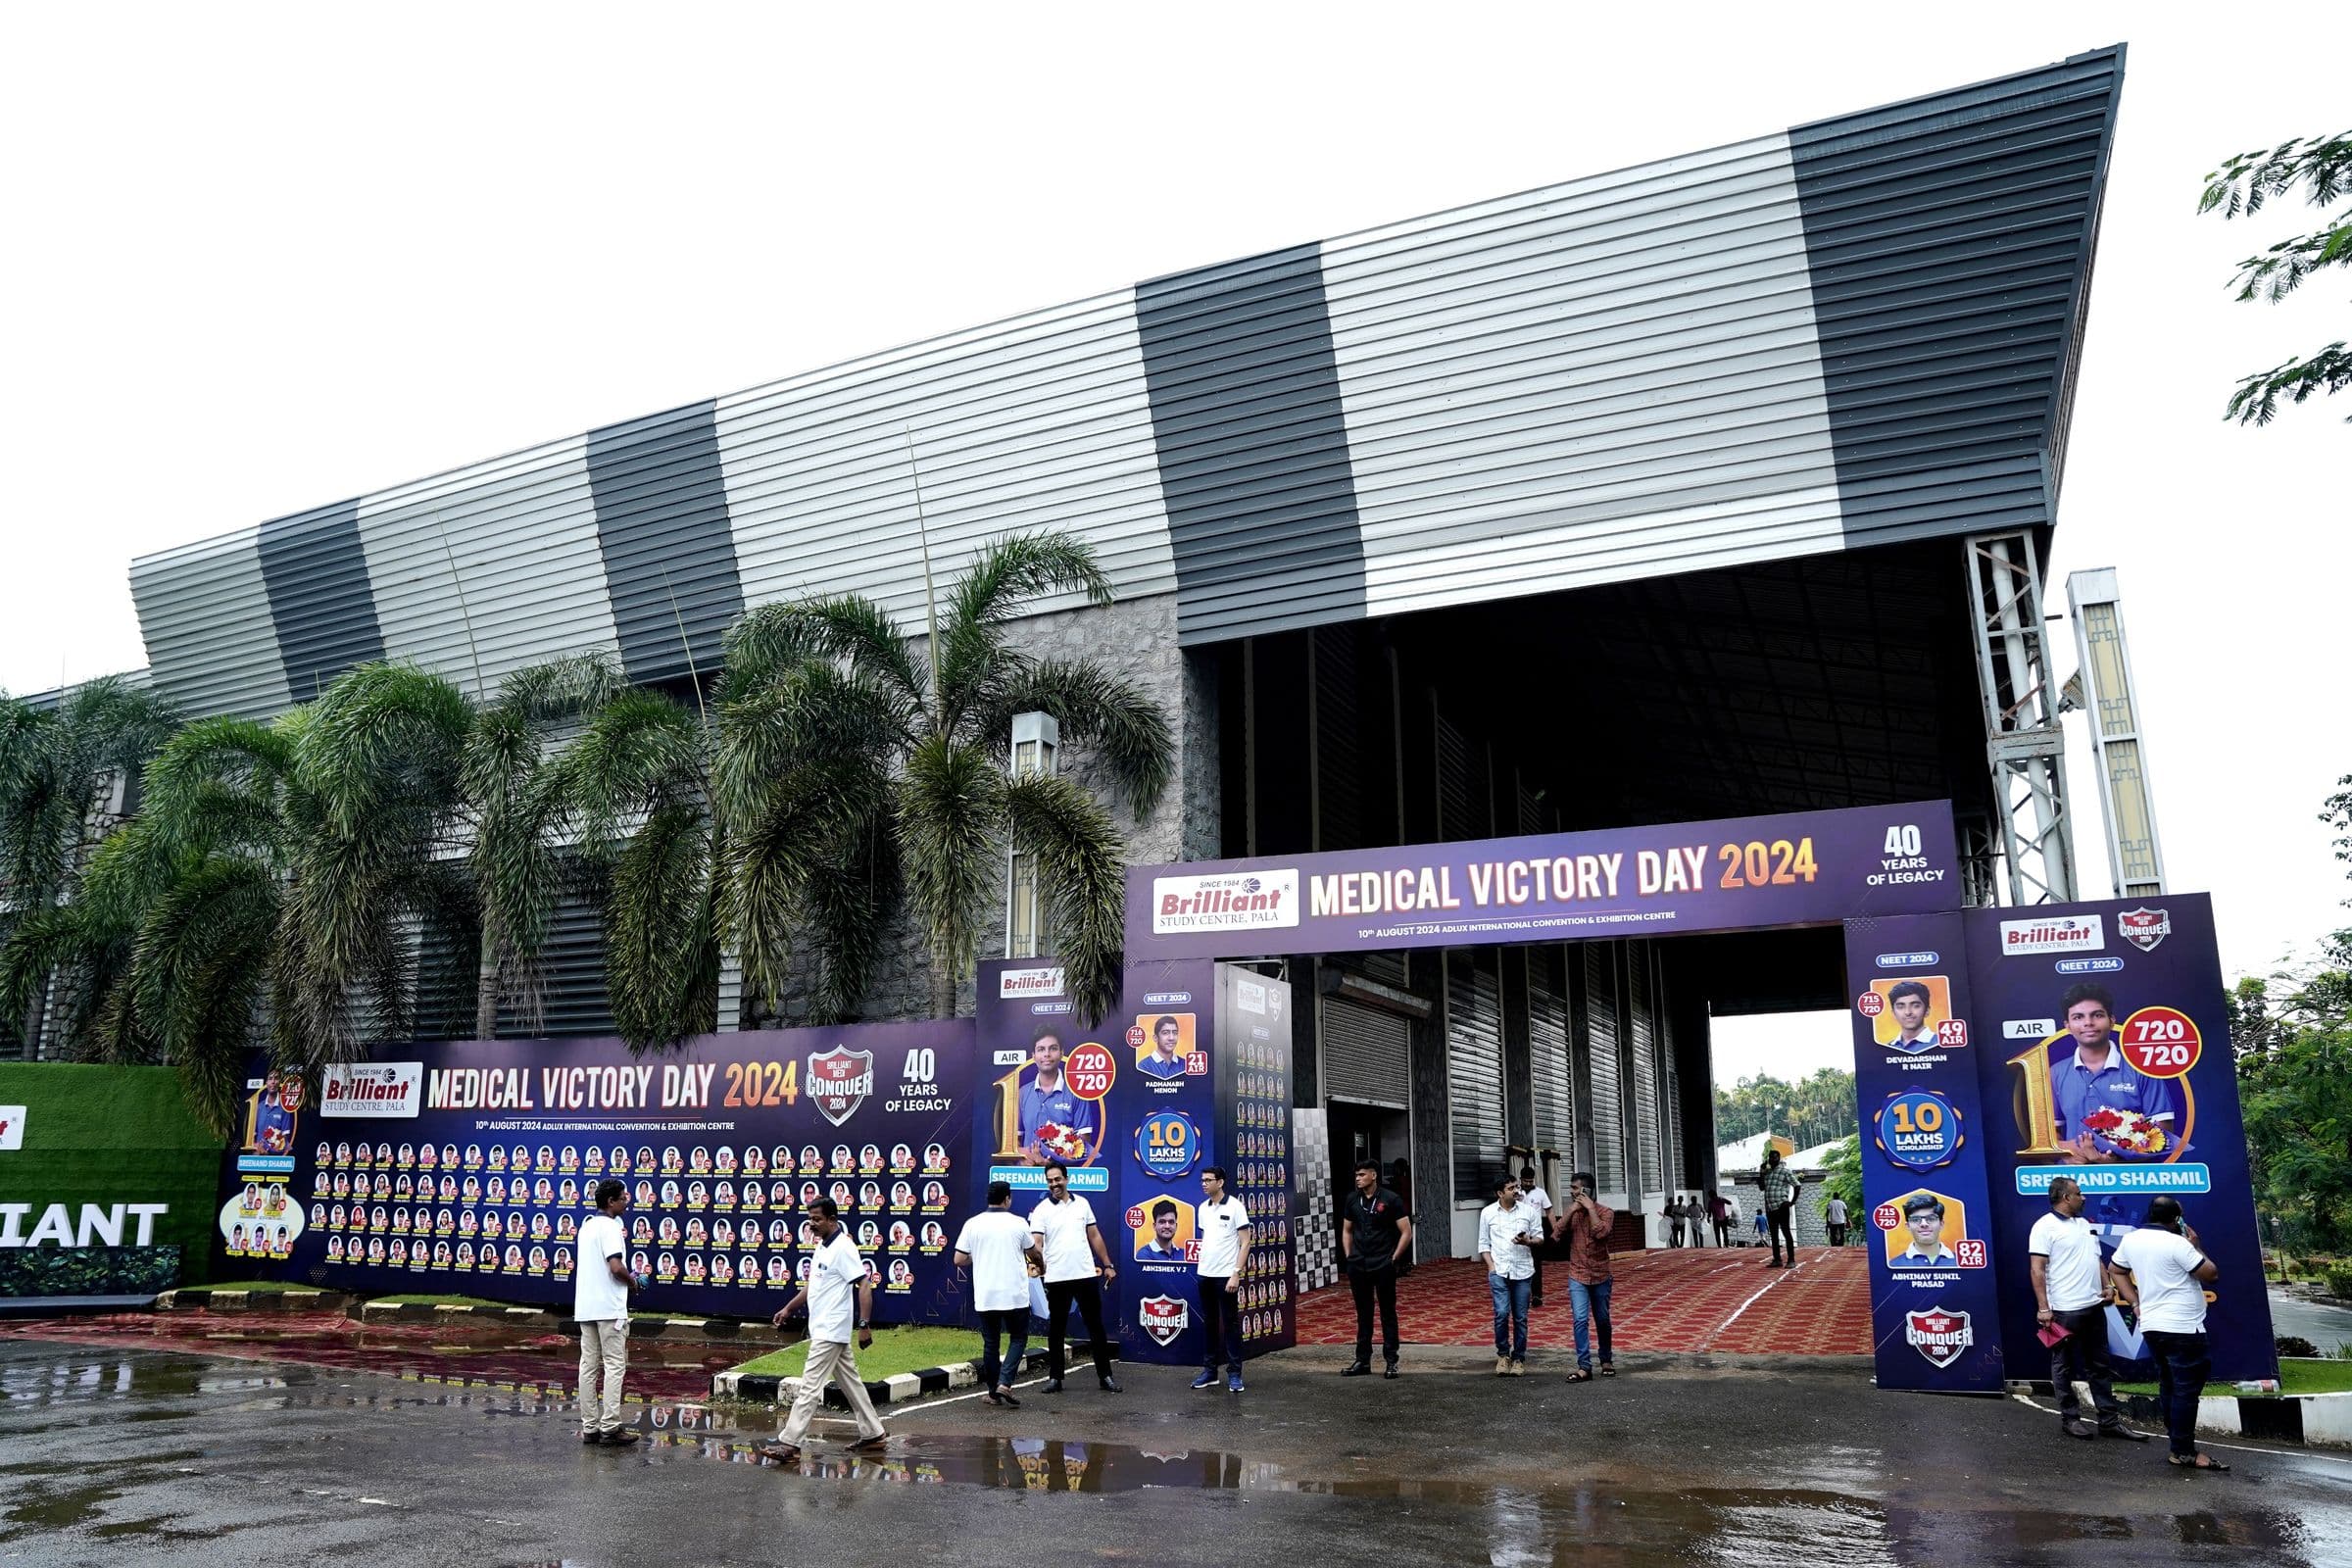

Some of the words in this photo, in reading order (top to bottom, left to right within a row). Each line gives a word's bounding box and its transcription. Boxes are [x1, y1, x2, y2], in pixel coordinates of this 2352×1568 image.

[1885, 825, 1921, 857] 40
[1882, 858, 1928, 870] YEARS
[1310, 866, 1459, 916] MEDICAL
[1468, 853, 1623, 906] VICTORY
[1638, 846, 1708, 895] DAY
[1719, 838, 1818, 888] 2024
[1867, 874, 1886, 886] OF
[1888, 869, 1944, 884] LEGACY
[1160, 890, 1281, 915] Brilliant
[1160, 915, 1197, 926] STUDY
[1200, 913, 1248, 925] CENTRE,
[1251, 912, 1278, 922] PALA
[1376, 927, 1414, 937] AUGUST
[1417, 925, 1440, 934] 2024
[1469, 921, 1531, 931] INTERNATIONAL
[1533, 917, 1588, 927] CONVENTION
[1596, 913, 1641, 923] EXHIBITION
[1643, 911, 1676, 920] CENTRE
[2008, 927, 2090, 944] Brilliant
[2118, 921, 2171, 937] CONQUER
[1910, 955, 1933, 963] 2024
[2061, 961, 2089, 970] NEET
[2092, 959, 2118, 969] 2024
[1004, 977, 1056, 990] Brilliant
[1940, 1022, 1963, 1036] 49
[2016, 1023, 2044, 1035] AIR
[2134, 1020, 2184, 1041] 720
[1941, 1036, 1963, 1045] AIR
[1001, 1054, 1018, 1062] AIR
[1076, 1054, 1106, 1070] 720
[1188, 1054, 1204, 1065] 21
[1886, 1054, 1947, 1063] DEVADARSHAN
[2139, 1046, 2189, 1066] 720
[904, 1049, 935, 1083] 40
[326, 1078, 409, 1100] Brilliant
[427, 1068, 534, 1108] MEDICAL
[543, 1064, 654, 1108] VICTORY
[662, 1063, 716, 1108] DAY
[723, 1060, 799, 1107] 2024
[807, 1070, 873, 1097] CONQUER
[1076, 1074, 1106, 1090] 720
[900, 1084, 938, 1097] YEARS
[324, 1102, 349, 1110] STUDY
[386, 1102, 405, 1110] PALA
[830, 1098, 847, 1109] 2024
[886, 1101, 901, 1111] OF
[905, 1099, 952, 1111] LEGACY
[1892, 1102, 1942, 1132] 10
[490, 1121, 520, 1130] AUGUST
[522, 1121, 541, 1130] 2024
[564, 1122, 614, 1131] INTERNATIONAL
[616, 1122, 660, 1131] CONVENTION
[1150, 1121, 1186, 1147] 10
[1895, 1133, 1944, 1145] LAKHS
[1150, 1148, 1185, 1157] LAKHS
[2021, 1173, 2116, 1187] SREAND
[2120, 1172, 2205, 1186] SHARMIL
[1879, 1218, 1896, 1227] 720
[1959, 1243, 1982, 1256] 82
[1960, 1256, 1983, 1265] AIR
[1140, 1311, 1188, 1328] CONQUER
[1906, 1327, 1973, 1346] CONQUER
